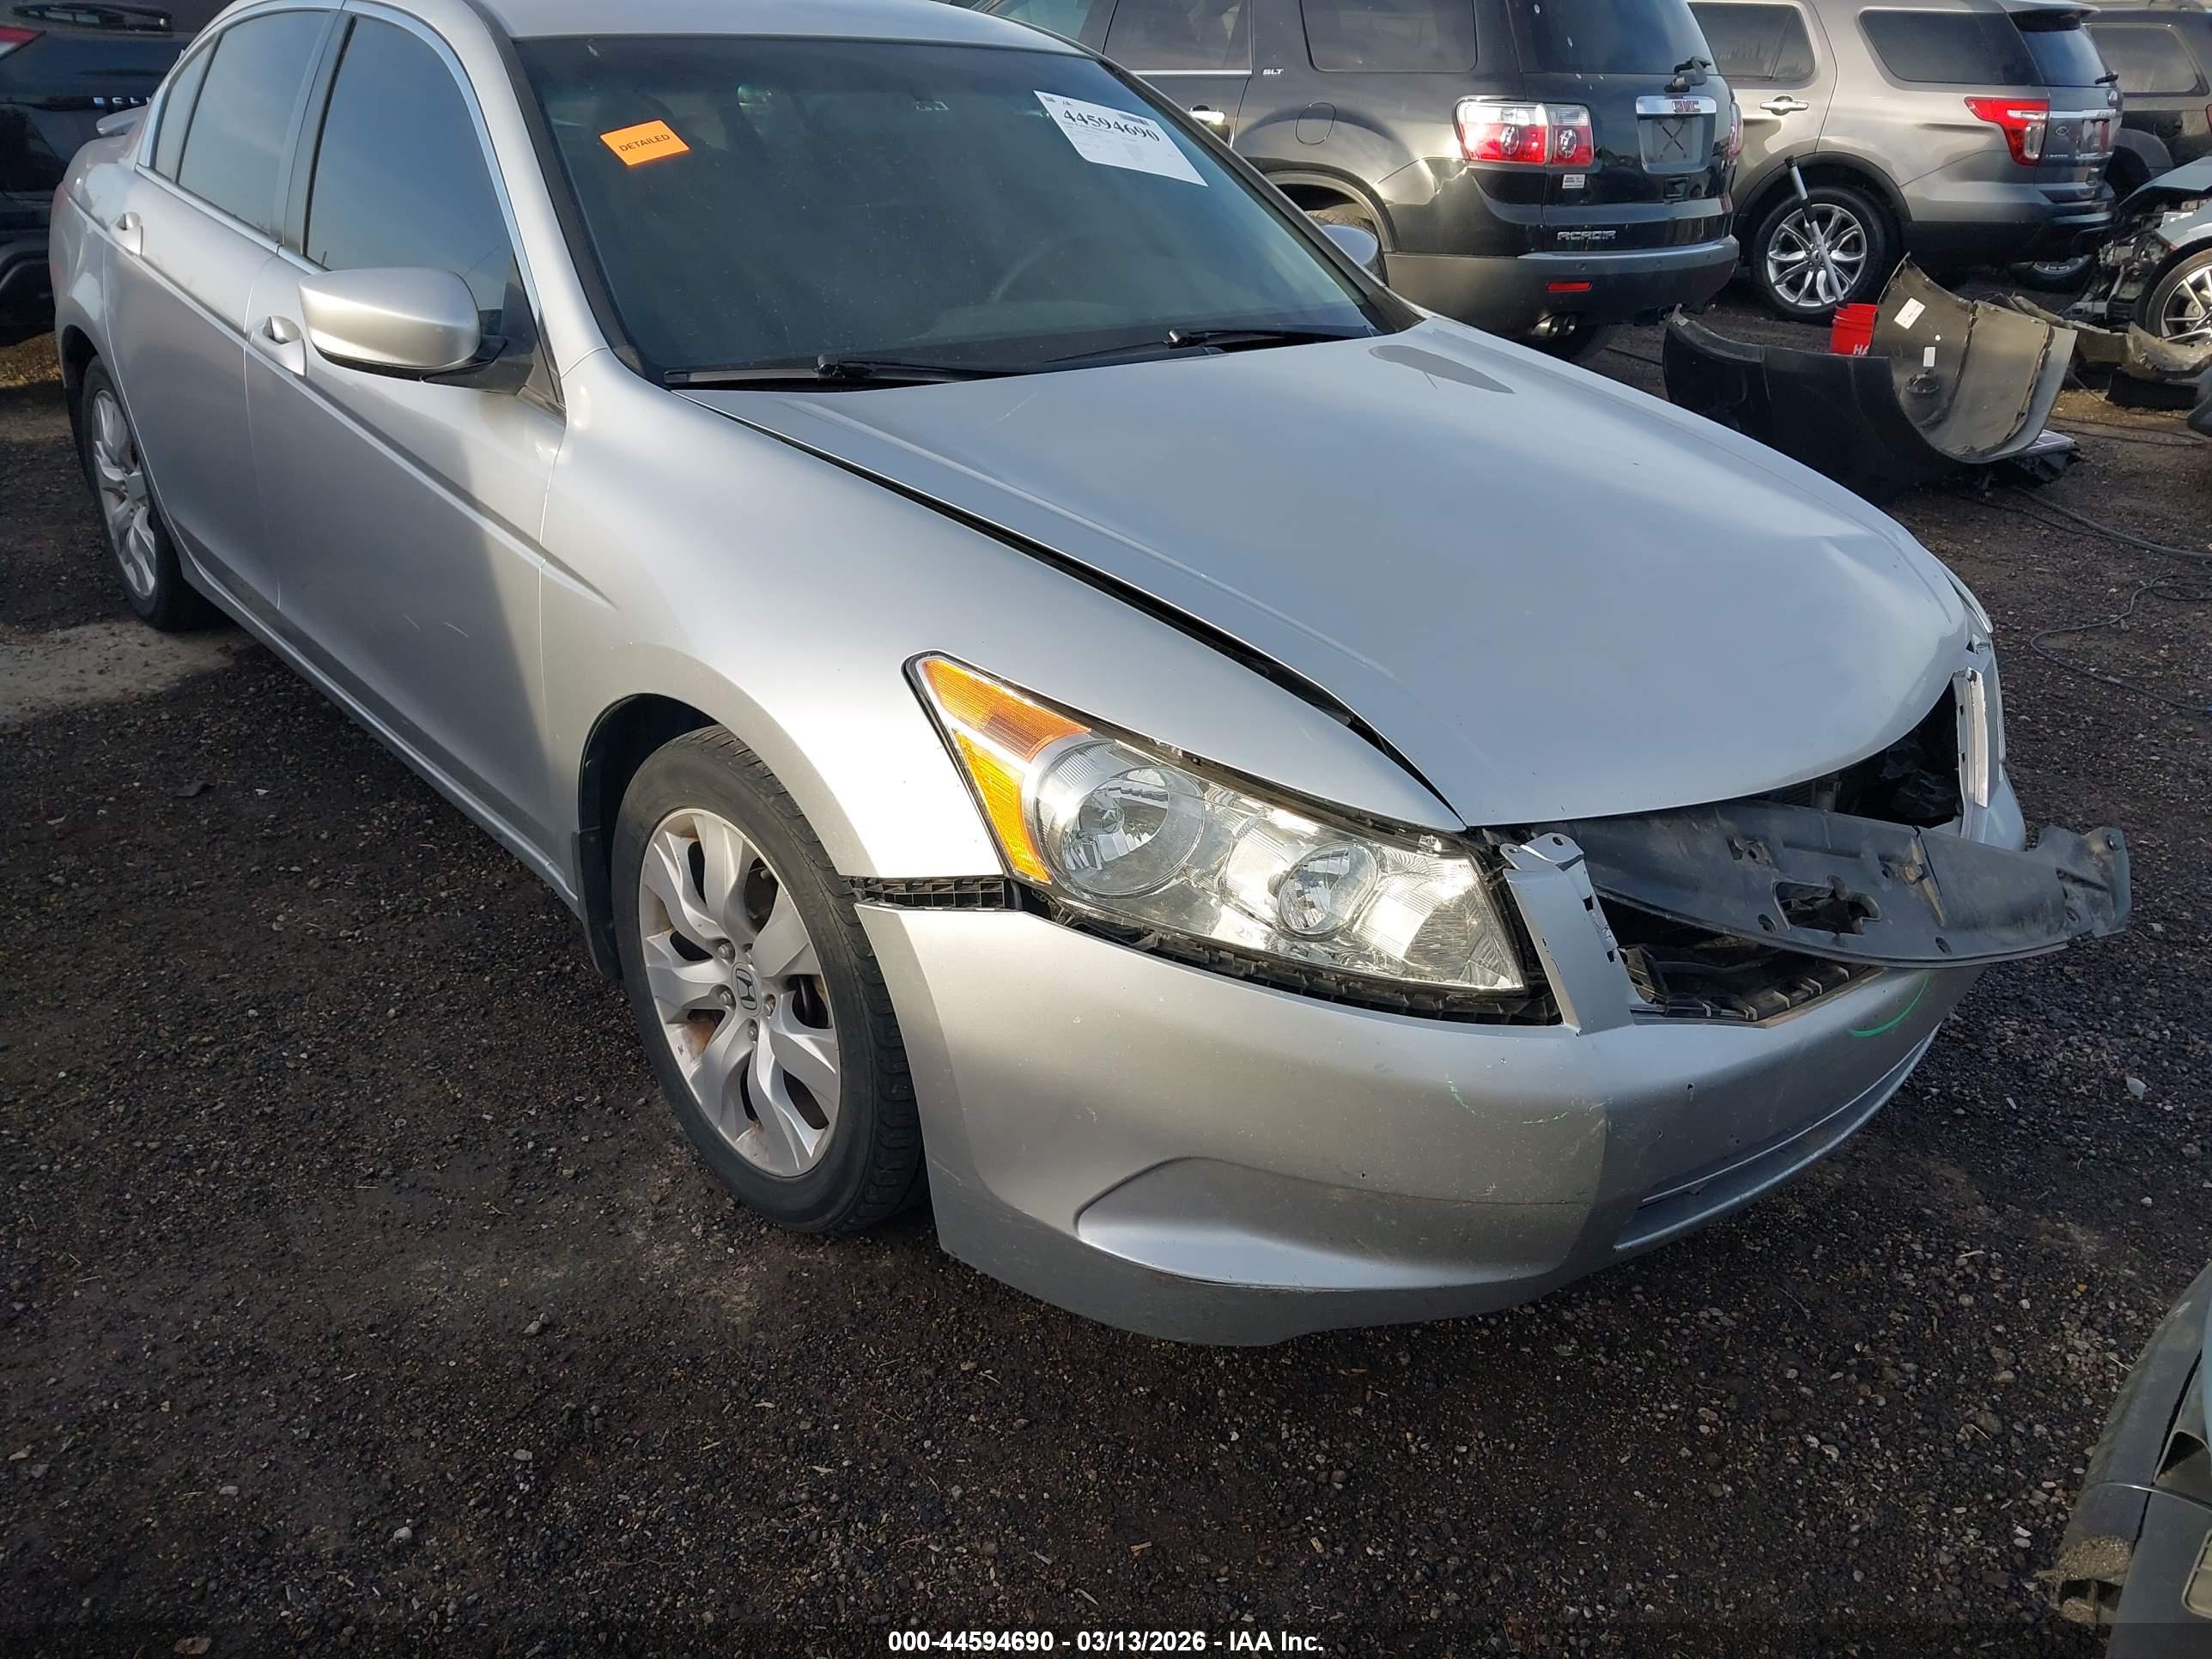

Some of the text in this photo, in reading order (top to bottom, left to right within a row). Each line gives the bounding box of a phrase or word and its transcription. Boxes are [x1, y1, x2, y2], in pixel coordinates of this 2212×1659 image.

[1672, 100, 1701, 112] GMC
[1063, 110, 1160, 142] 44594690
[619, 134, 670, 151] DETAILED
[1557, 230, 1616, 240] ACADIA
